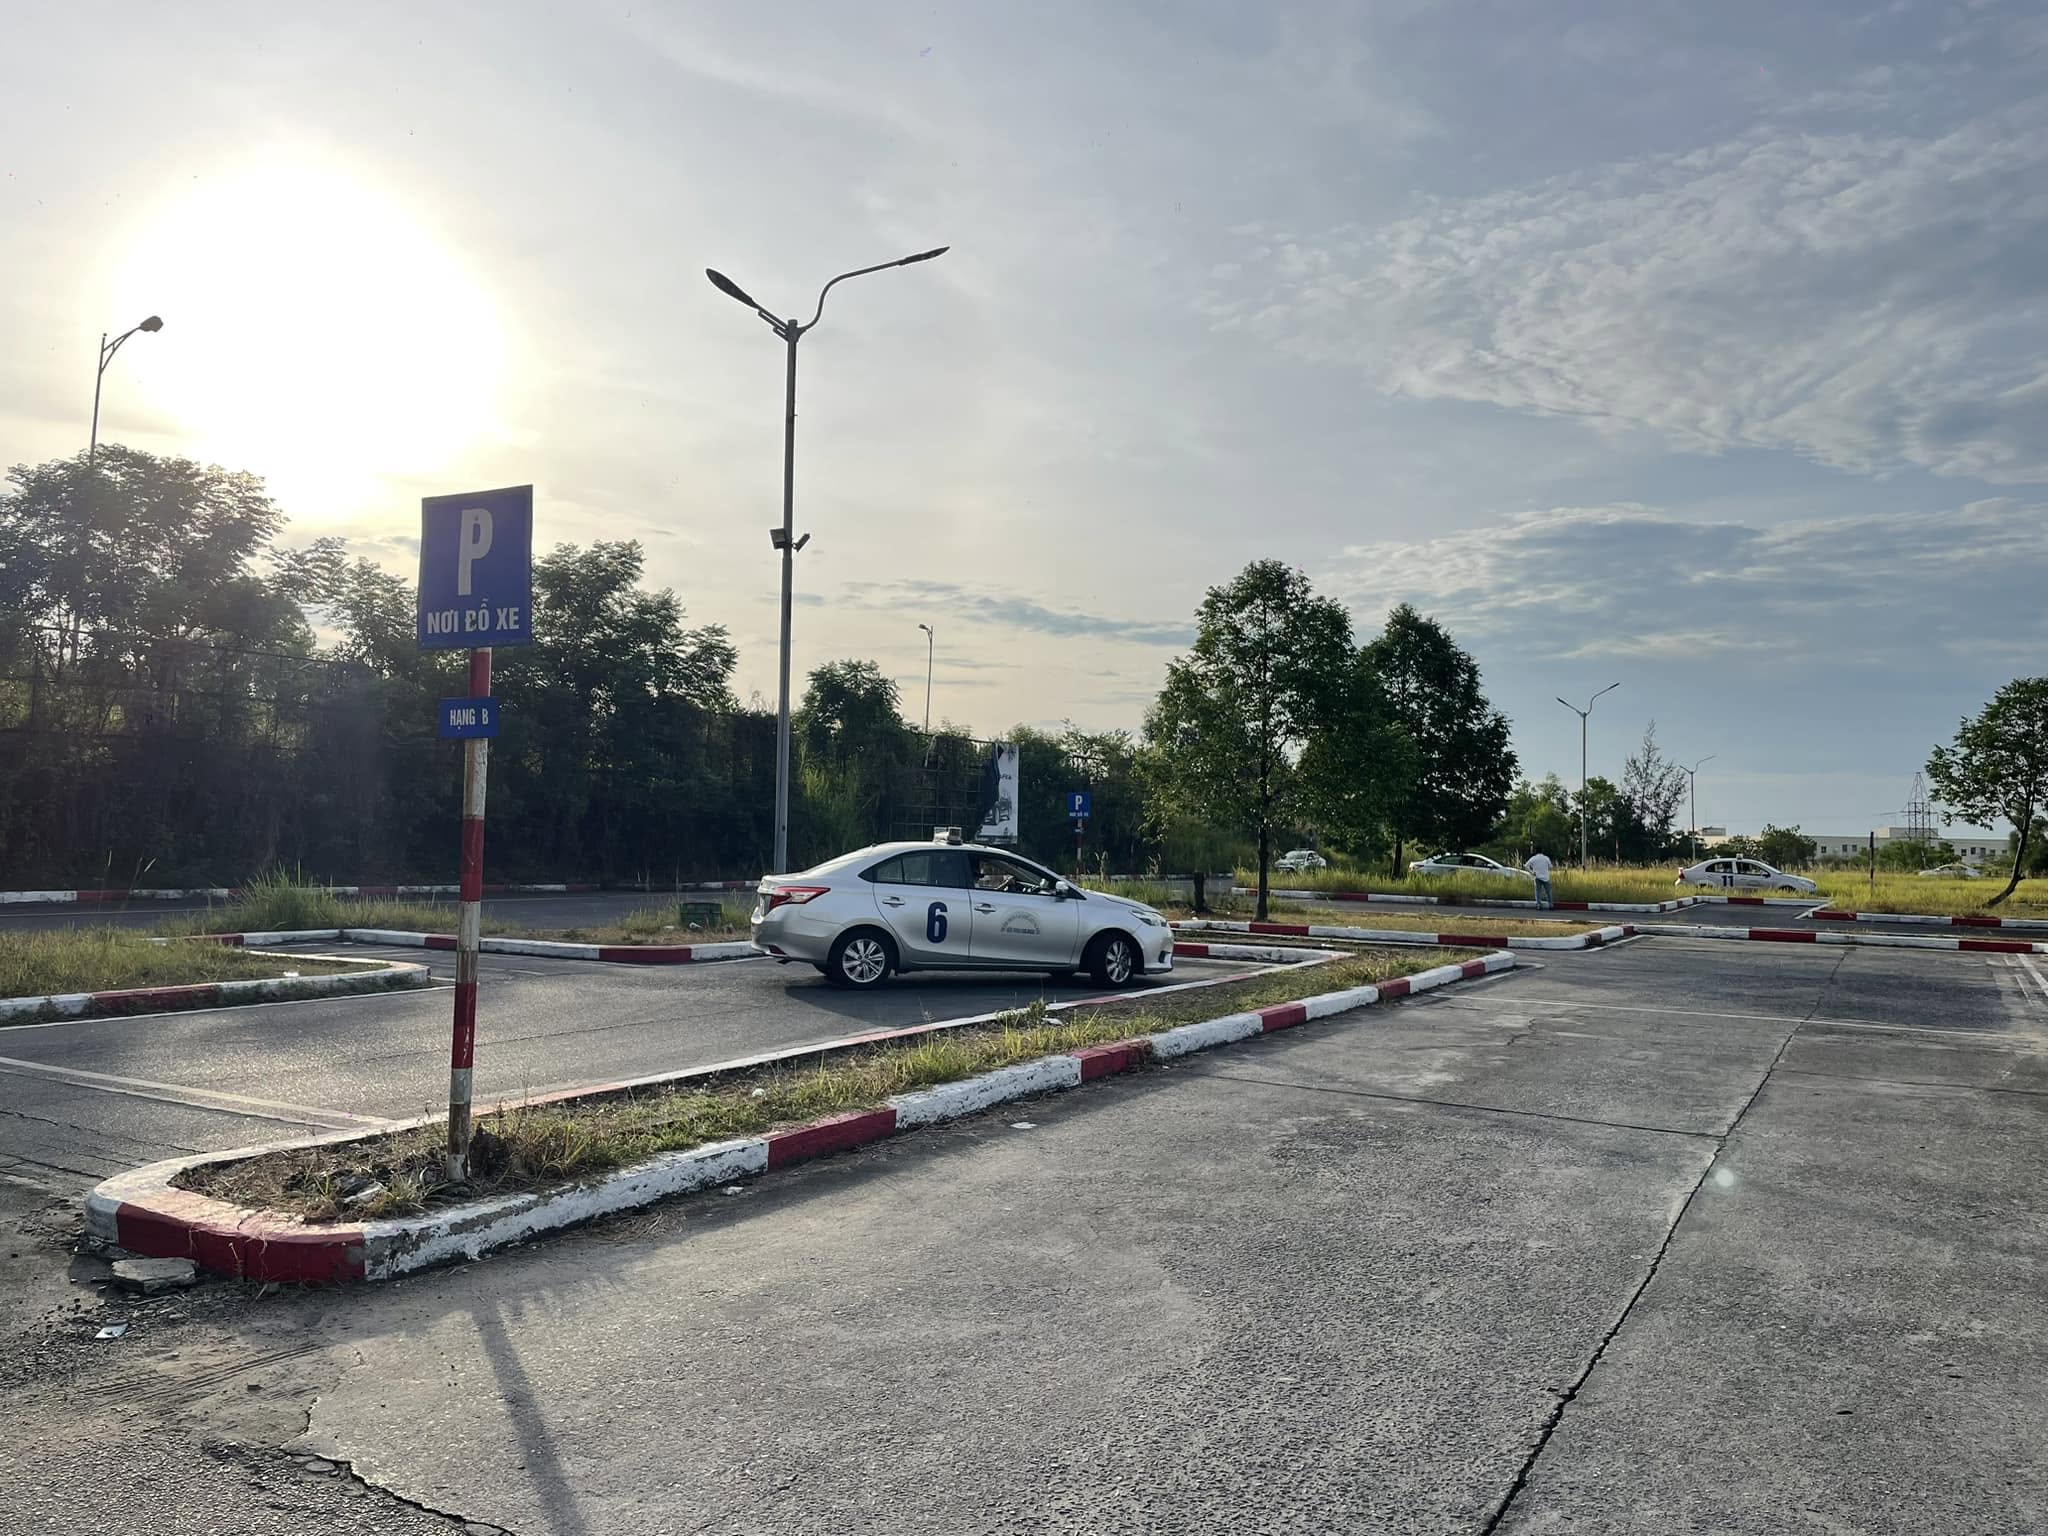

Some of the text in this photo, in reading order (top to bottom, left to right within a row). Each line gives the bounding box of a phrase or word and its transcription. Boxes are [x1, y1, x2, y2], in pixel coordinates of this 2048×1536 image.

[458, 508, 493, 596] P
[427, 609, 459, 634] NƠI
[495, 607, 520, 630] XE
[450, 708, 489, 730] HẠNG B
[1075, 794, 1083, 810] P
[1721, 875, 1734, 887] 11
[926, 901, 948, 944] 6
